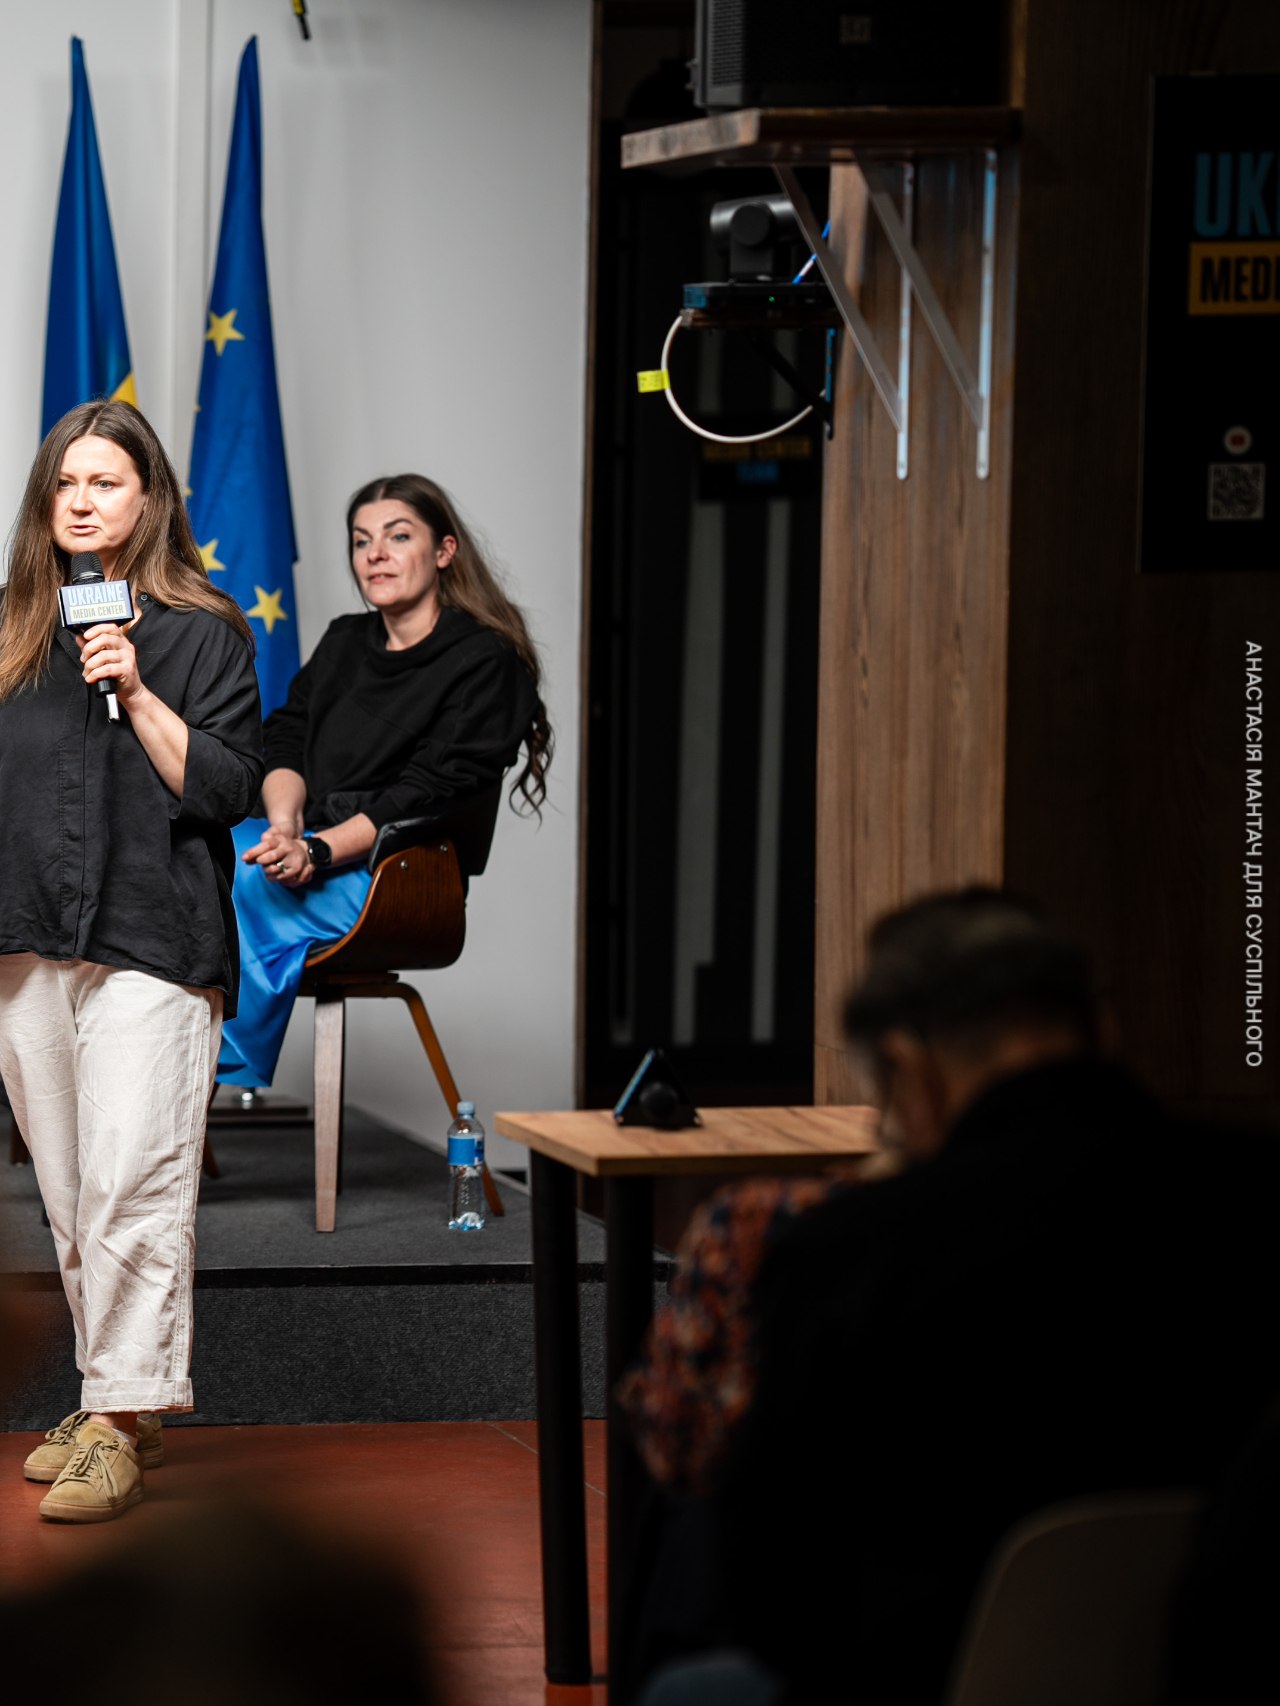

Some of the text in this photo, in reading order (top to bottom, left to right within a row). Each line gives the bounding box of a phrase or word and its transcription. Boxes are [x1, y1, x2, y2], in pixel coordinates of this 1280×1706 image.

[1193, 150, 1280, 239] UK
[67, 584, 124, 606] UKRAINE
[72, 604, 124, 619] MEDIA CENTER
